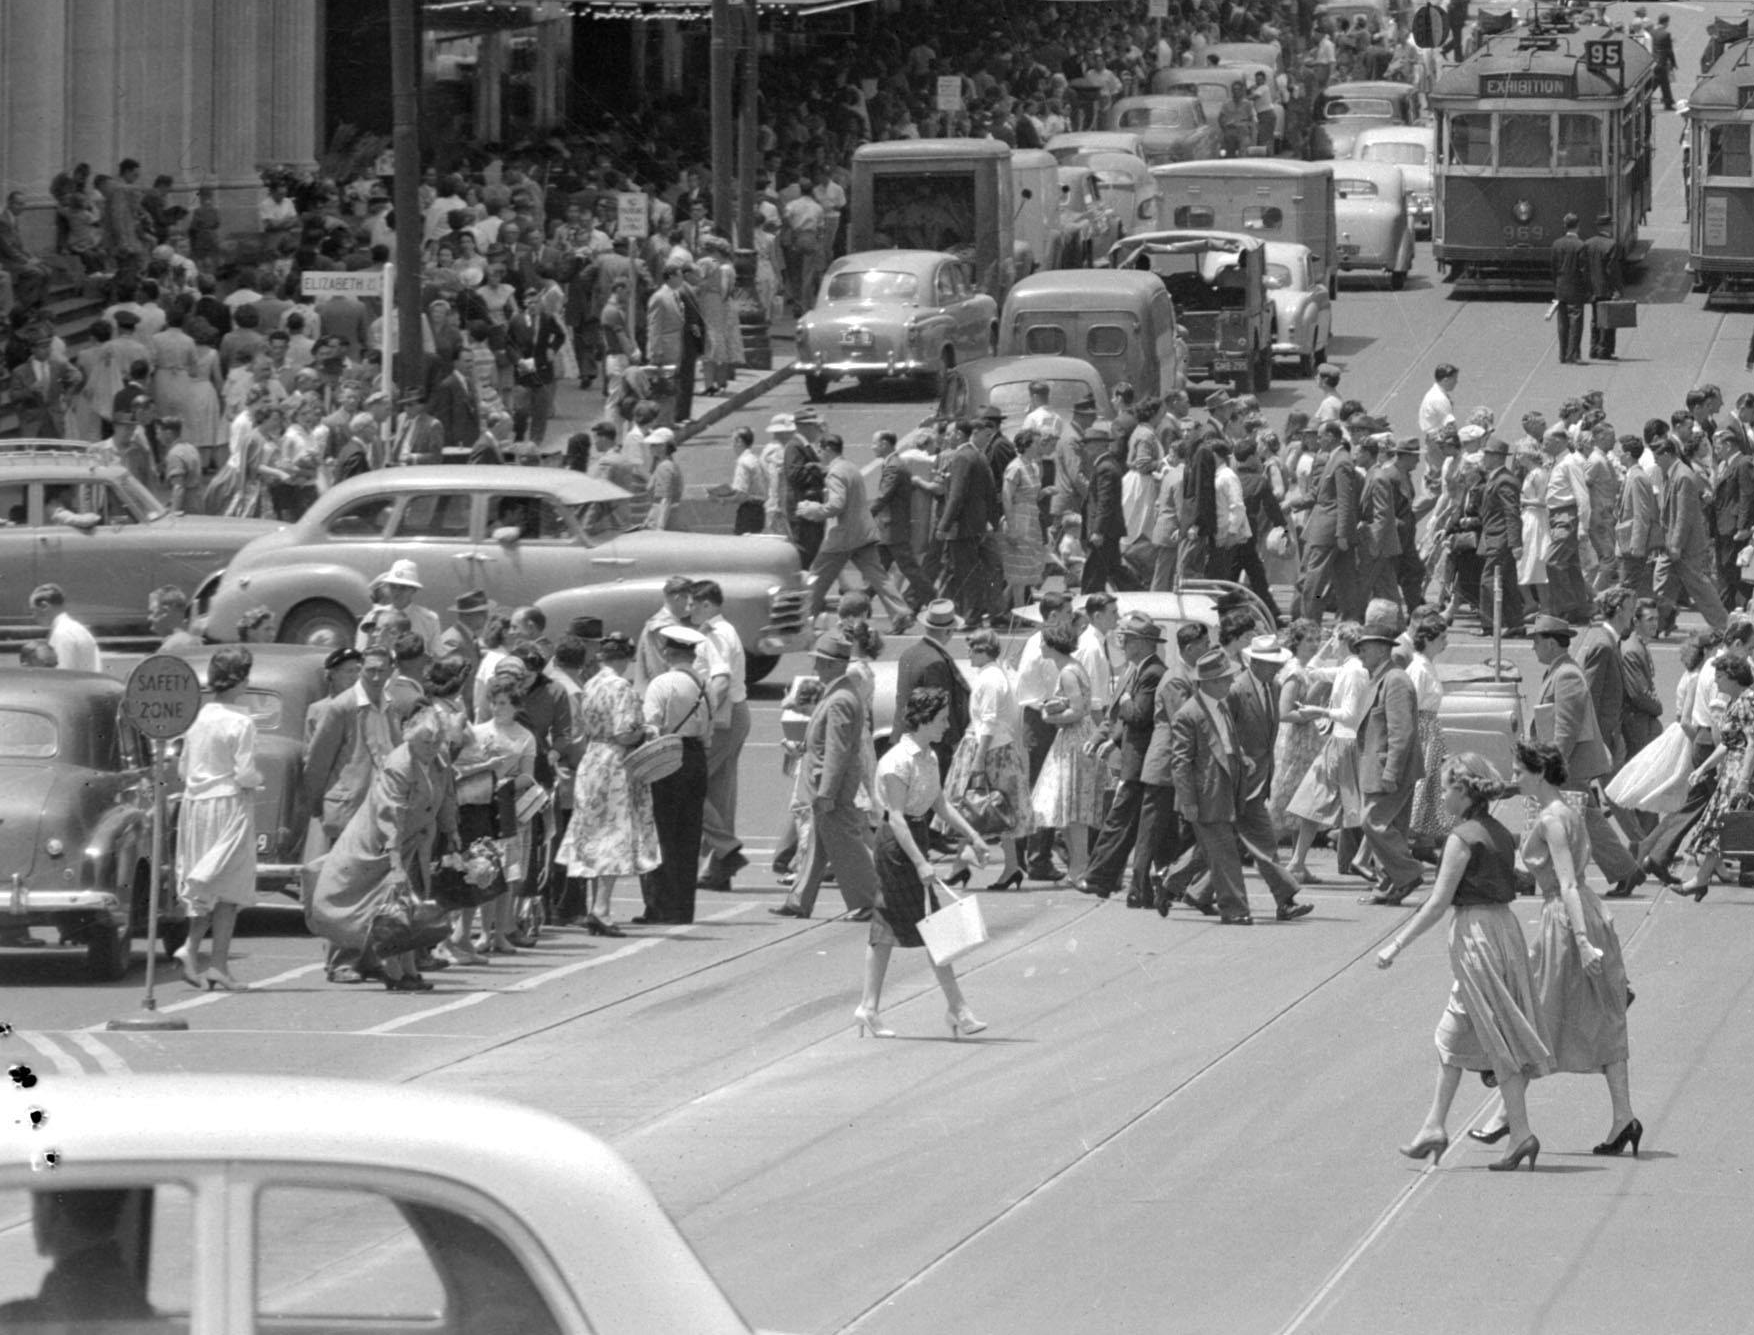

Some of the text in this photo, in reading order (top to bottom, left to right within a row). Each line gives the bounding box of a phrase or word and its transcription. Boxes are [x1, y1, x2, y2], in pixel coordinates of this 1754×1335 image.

[1590, 44, 1620, 65] 95
[1487, 79, 1565, 94] EXHIBITION
[1503, 225, 1543, 241] 969
[304, 277, 364, 291] ELIZABETH
[138, 675, 191, 693] SAFETY
[141, 701, 183, 719] ZONE
